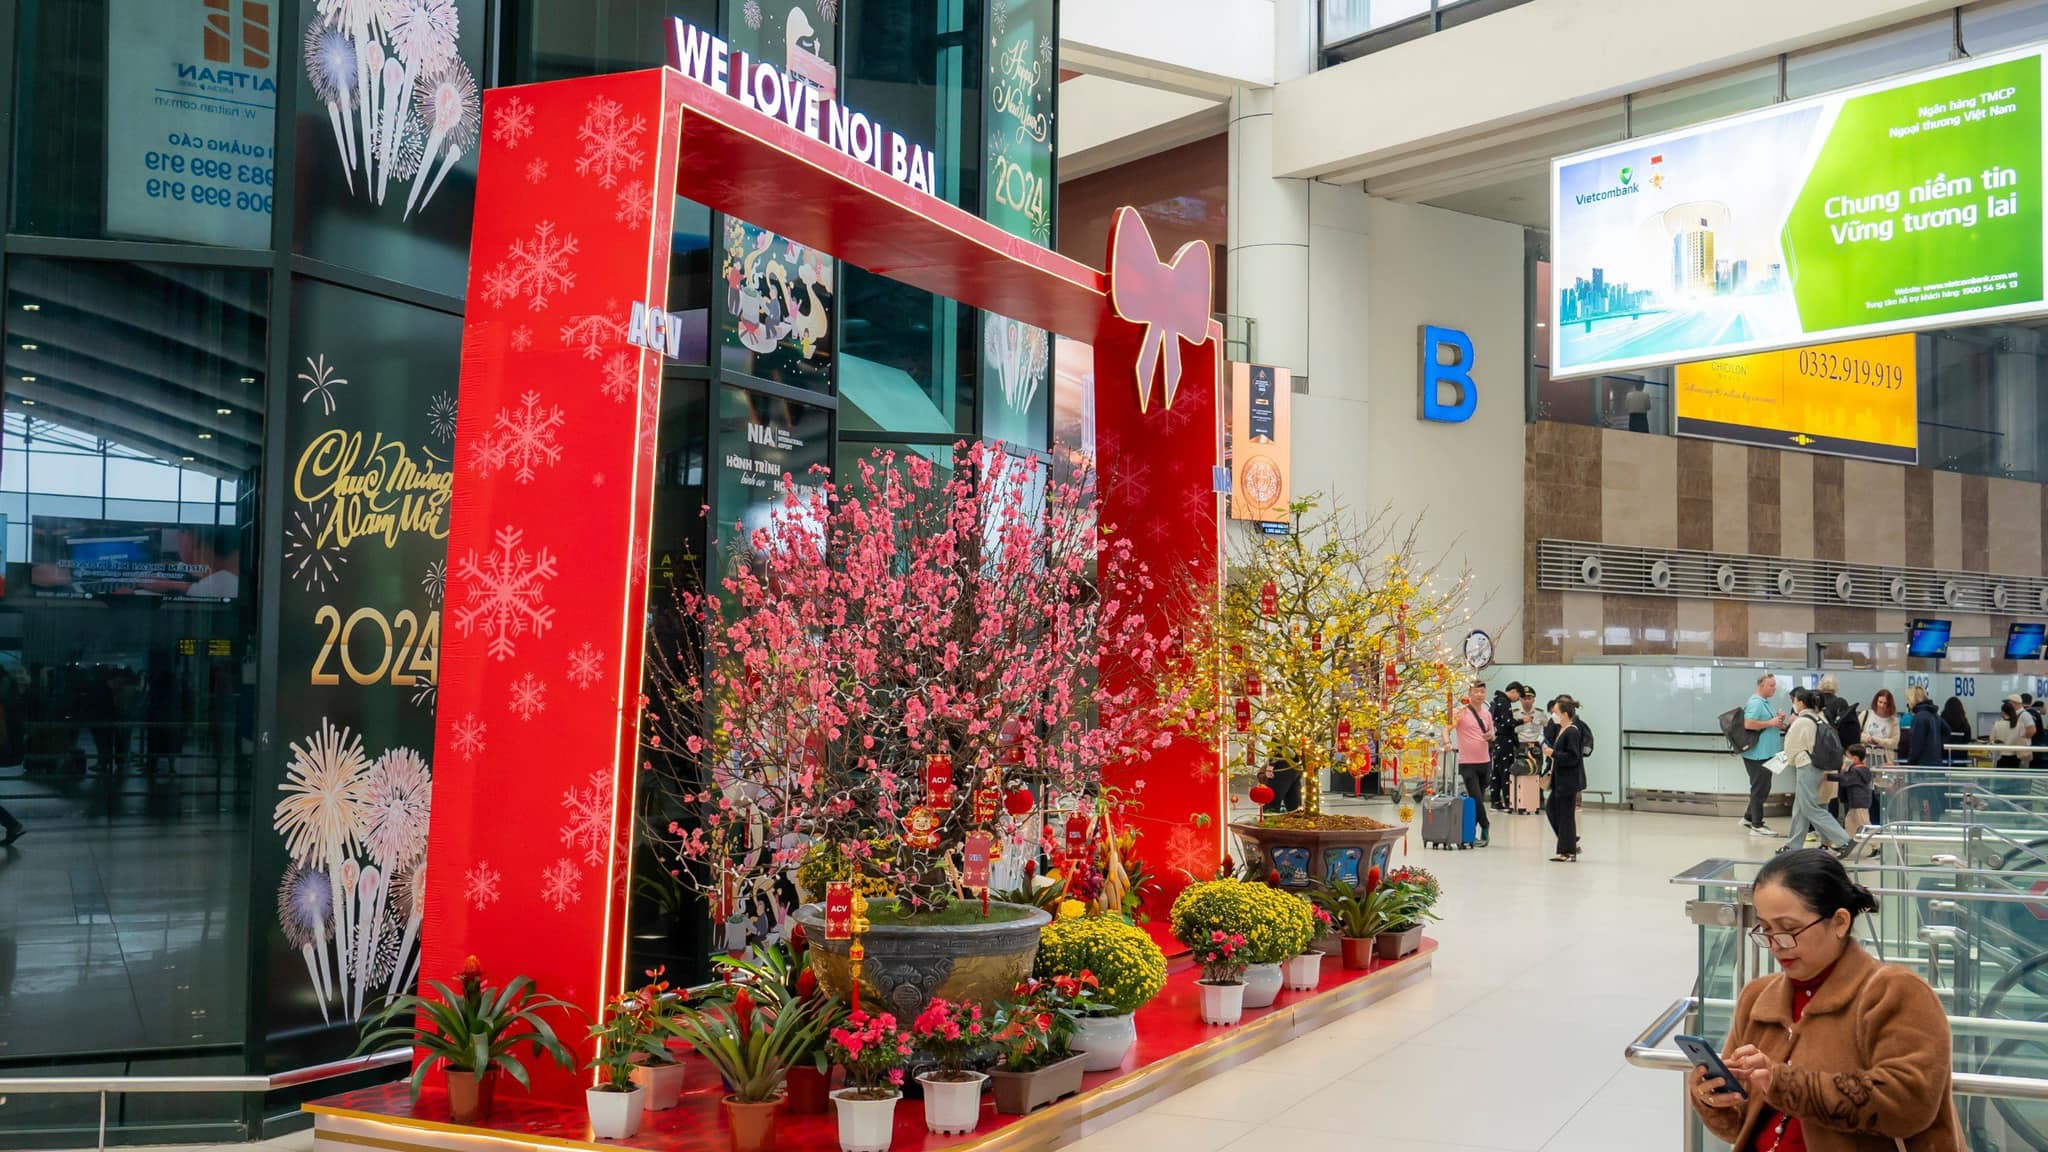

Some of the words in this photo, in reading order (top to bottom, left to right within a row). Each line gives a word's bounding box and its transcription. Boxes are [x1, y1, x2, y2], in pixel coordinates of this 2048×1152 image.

[1001, 40, 1040, 96] Happy
[674, 16, 728, 95] WE
[740, 51, 819, 141] LOVE
[829, 103, 881, 171] NOI
[893, 133, 936, 198] BAI
[1980, 87, 2016, 104] TMCP
[1990, 104, 2016, 117] Nam
[995, 155, 1043, 224] 2024
[1576, 182, 1639, 205] Vietcombank
[1824, 190, 1900, 219] Chung
[1909, 173, 1972, 204] niềm
[1981, 166, 2017, 190] tin
[1830, 219, 1894, 245] Vững
[1902, 204, 1977, 233] tương
[1987, 192, 2017, 218] lai
[627, 300, 682, 359] ACV
[1423, 325, 1478, 422] B
[1799, 349, 1902, 390] 0332.919.919
[748, 422, 776, 448] NIA
[726, 454, 752, 471] HÀNH
[754, 460, 781, 477] TRÌNH
[311, 605, 440, 686] 2024
[1955, 677, 1975, 697] B03
[830, 905, 847, 913] ACV
